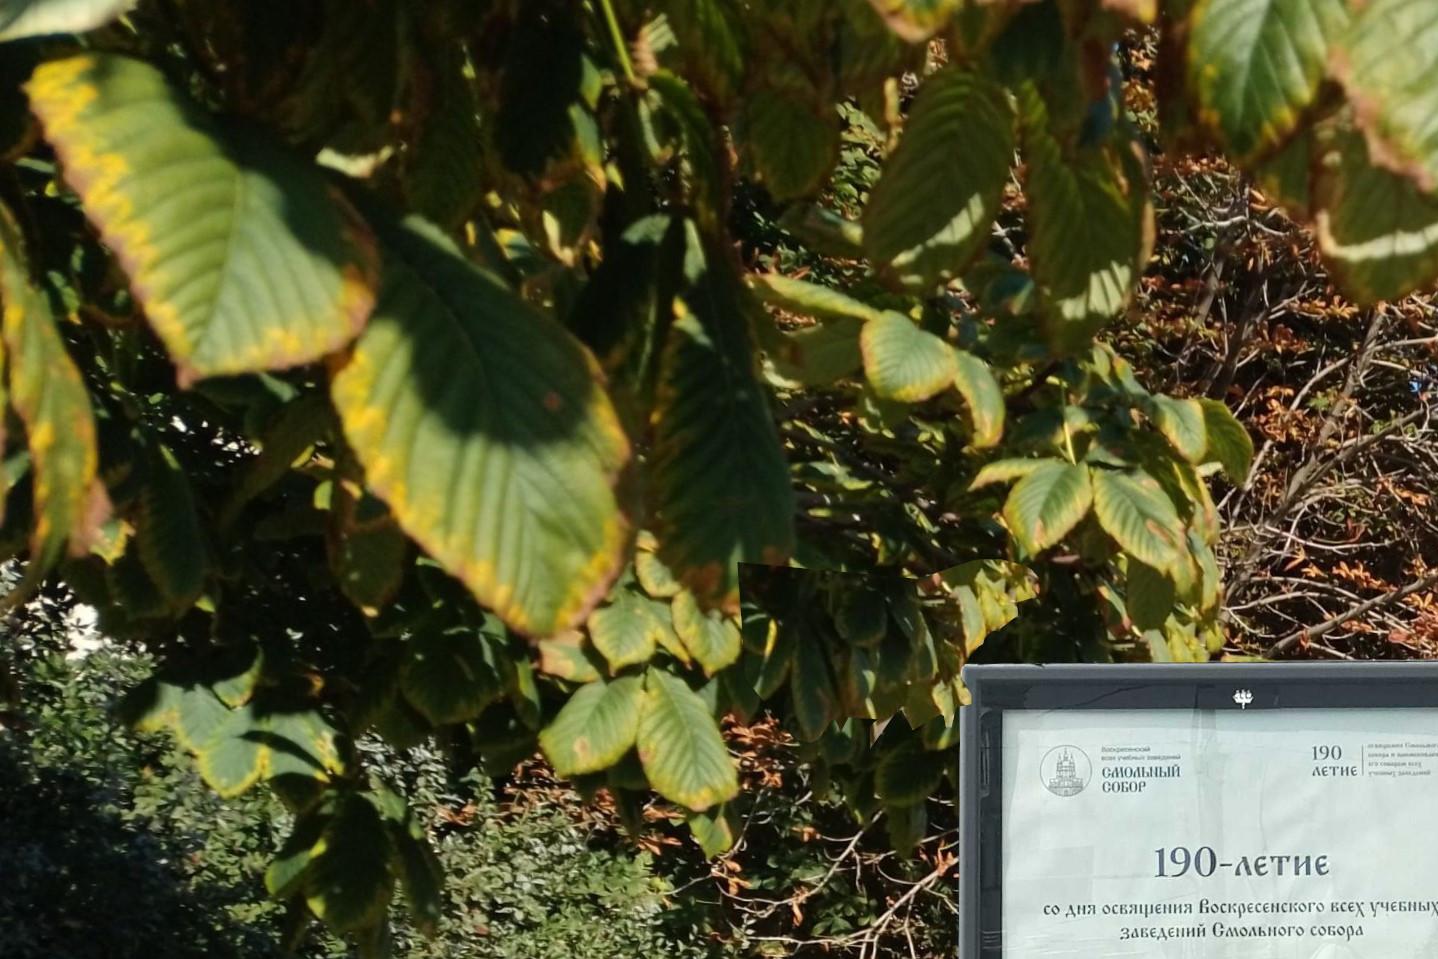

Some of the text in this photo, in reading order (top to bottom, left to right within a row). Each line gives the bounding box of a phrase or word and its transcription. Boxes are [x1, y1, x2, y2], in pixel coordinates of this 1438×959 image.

[1312, 745, 1342, 761] 190
[1102, 763, 1181, 778] СМОЛЬНЫЙ
[1102, 780, 1147, 793] СОБОР
[1043, 904, 1061, 916] со
[1065, 903, 1097, 918] дня
[1101, 903, 1193, 918] освящения
[1199, 898, 1325, 918] Воскресенского
[1330, 902, 1366, 918] всех
[1119, 922, 1364, 942] заведений Смольного собора
